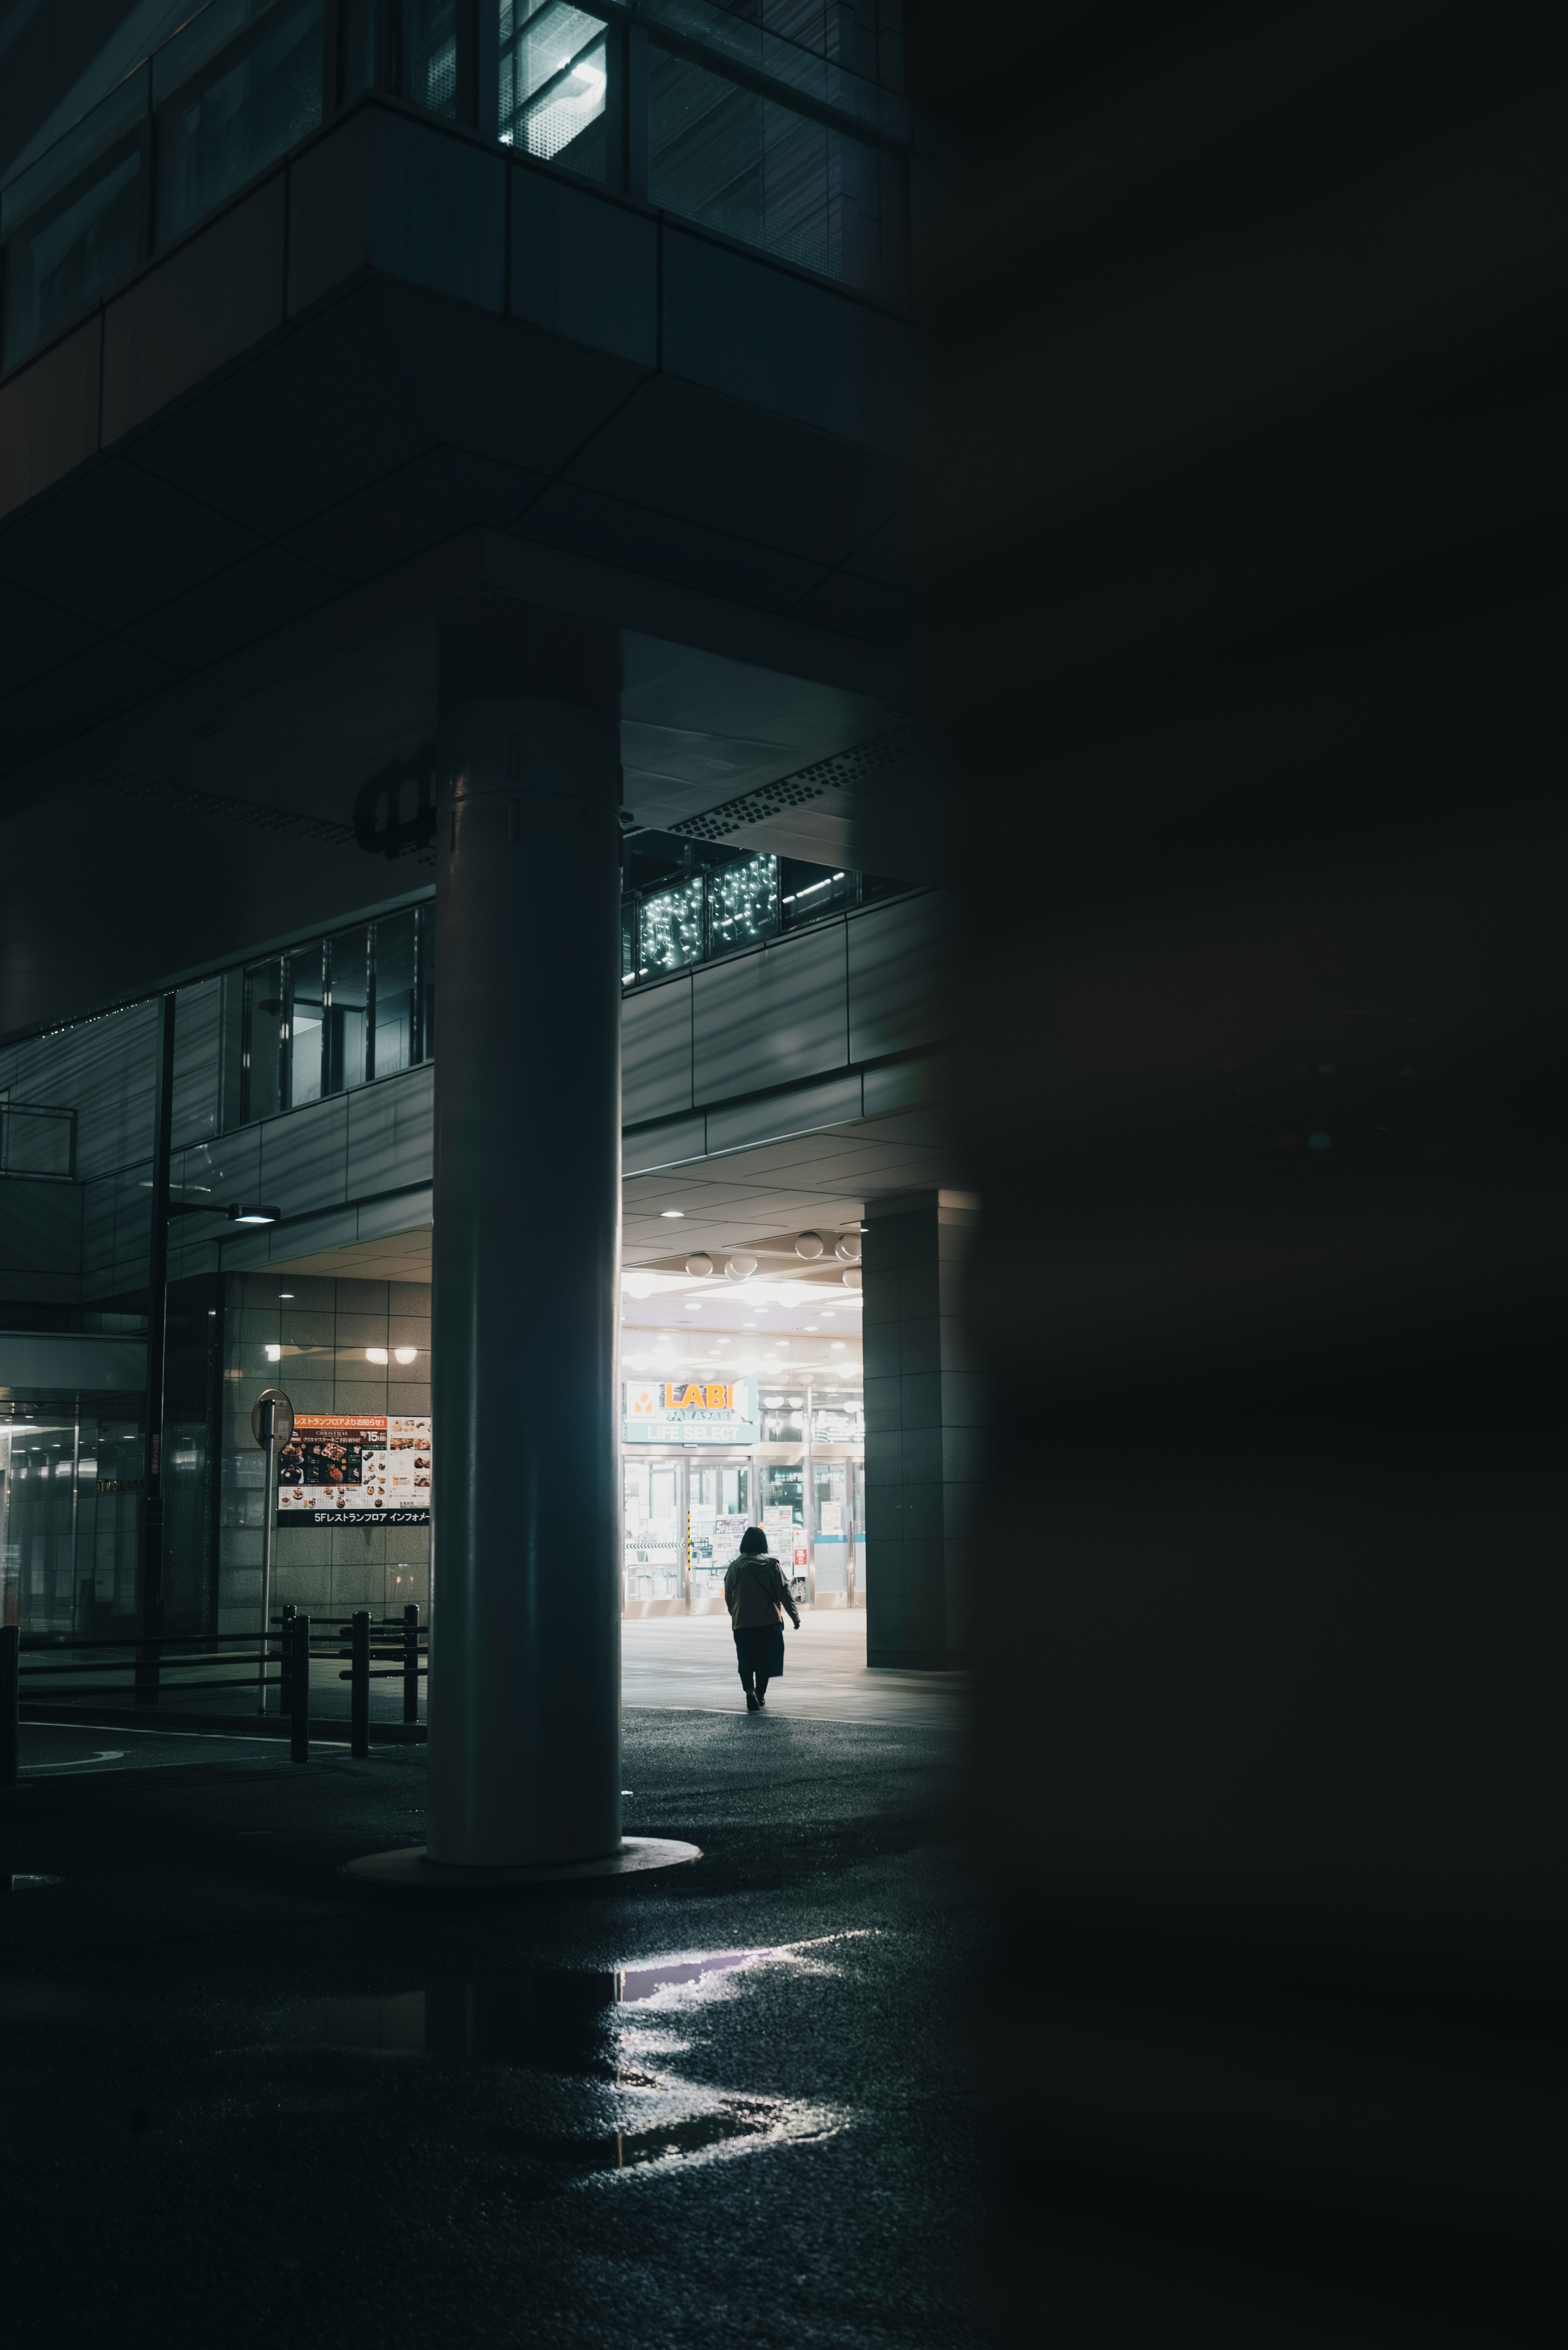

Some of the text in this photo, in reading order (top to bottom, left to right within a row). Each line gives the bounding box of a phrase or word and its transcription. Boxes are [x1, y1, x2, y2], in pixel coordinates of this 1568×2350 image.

[665, 1383, 733, 1409] LABI
[667, 1411, 733, 1421] TAKASAKI
[294, 1418, 385, 1426] レストランフロアよりお知らせ!
[647, 1426, 739, 1441] LIFE SELECT
[314, 1512, 387, 1522] 5Fレストランフロア
